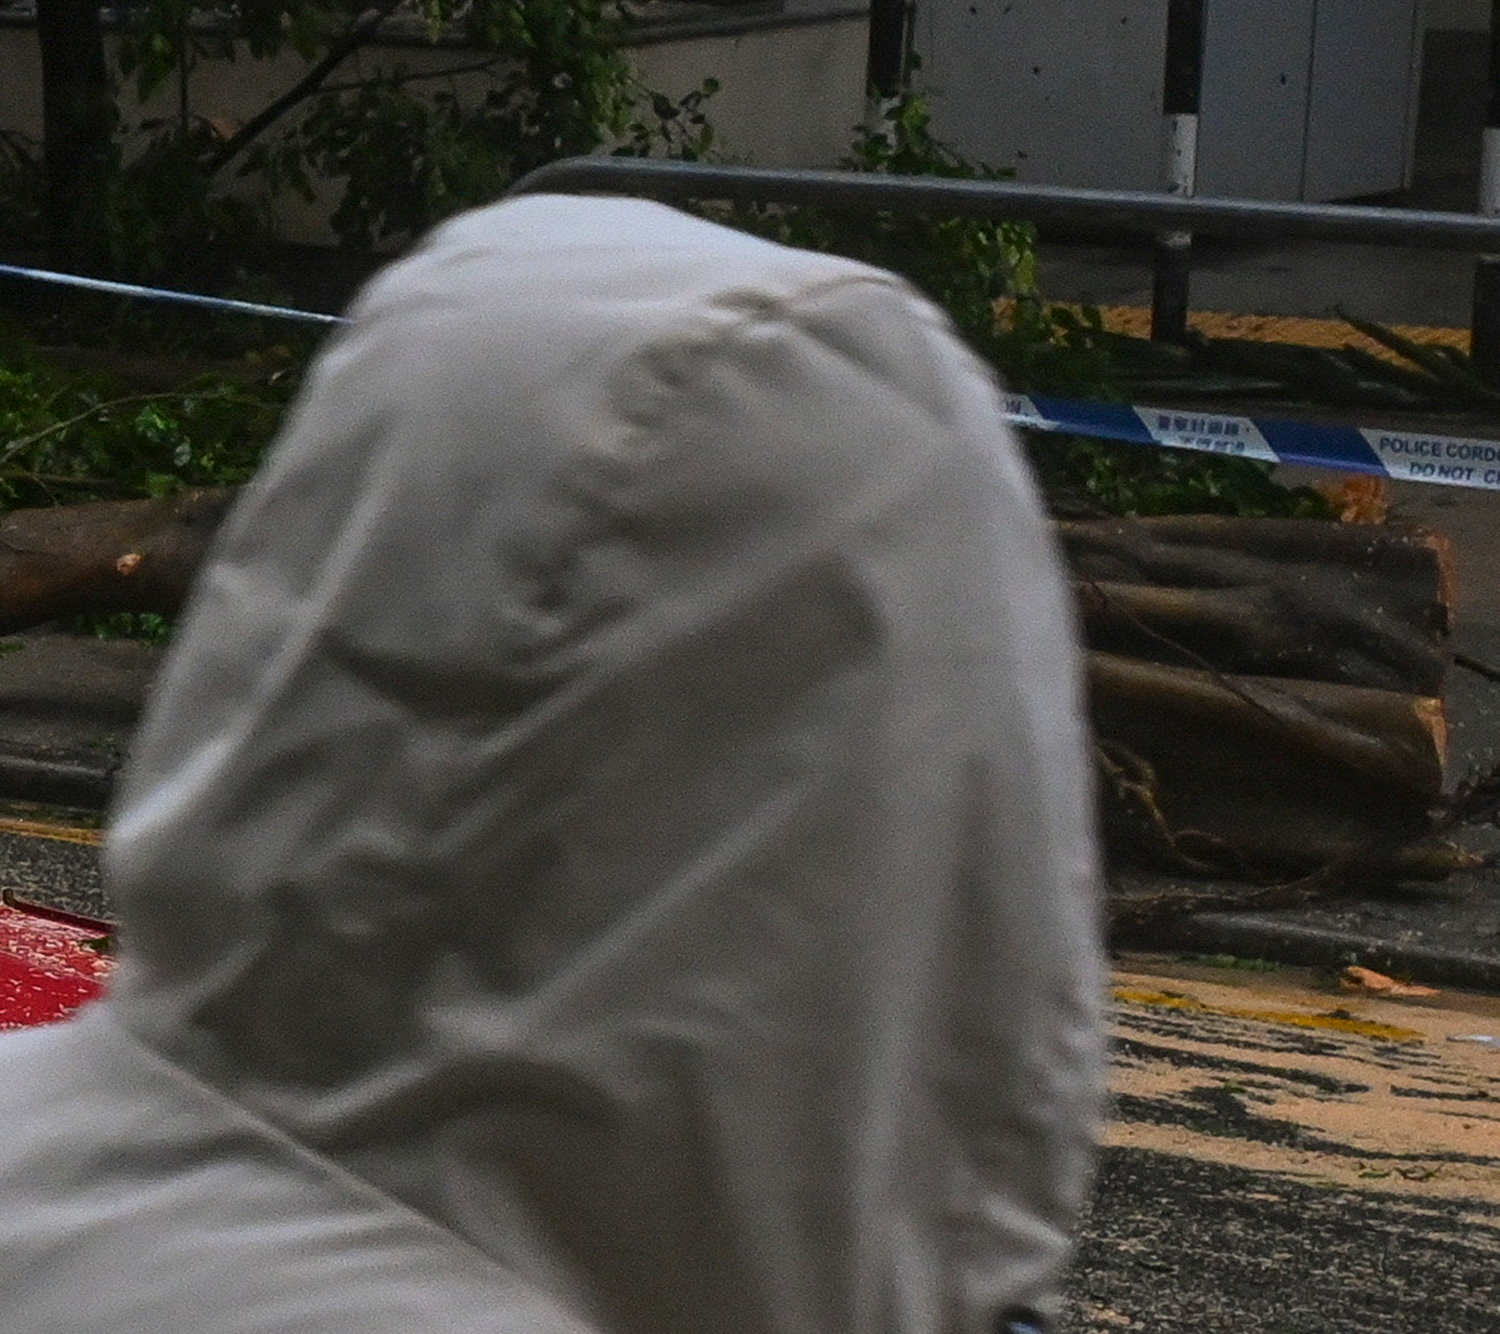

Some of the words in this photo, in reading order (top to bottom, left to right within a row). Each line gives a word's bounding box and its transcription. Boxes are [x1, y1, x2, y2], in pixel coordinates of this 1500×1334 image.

[1380, 437, 1441, 457] POLICE
[1446, 443, 1500, 463] CORD
[1409, 462, 1435, 477] DO
[1439, 465, 1474, 481] NOT
